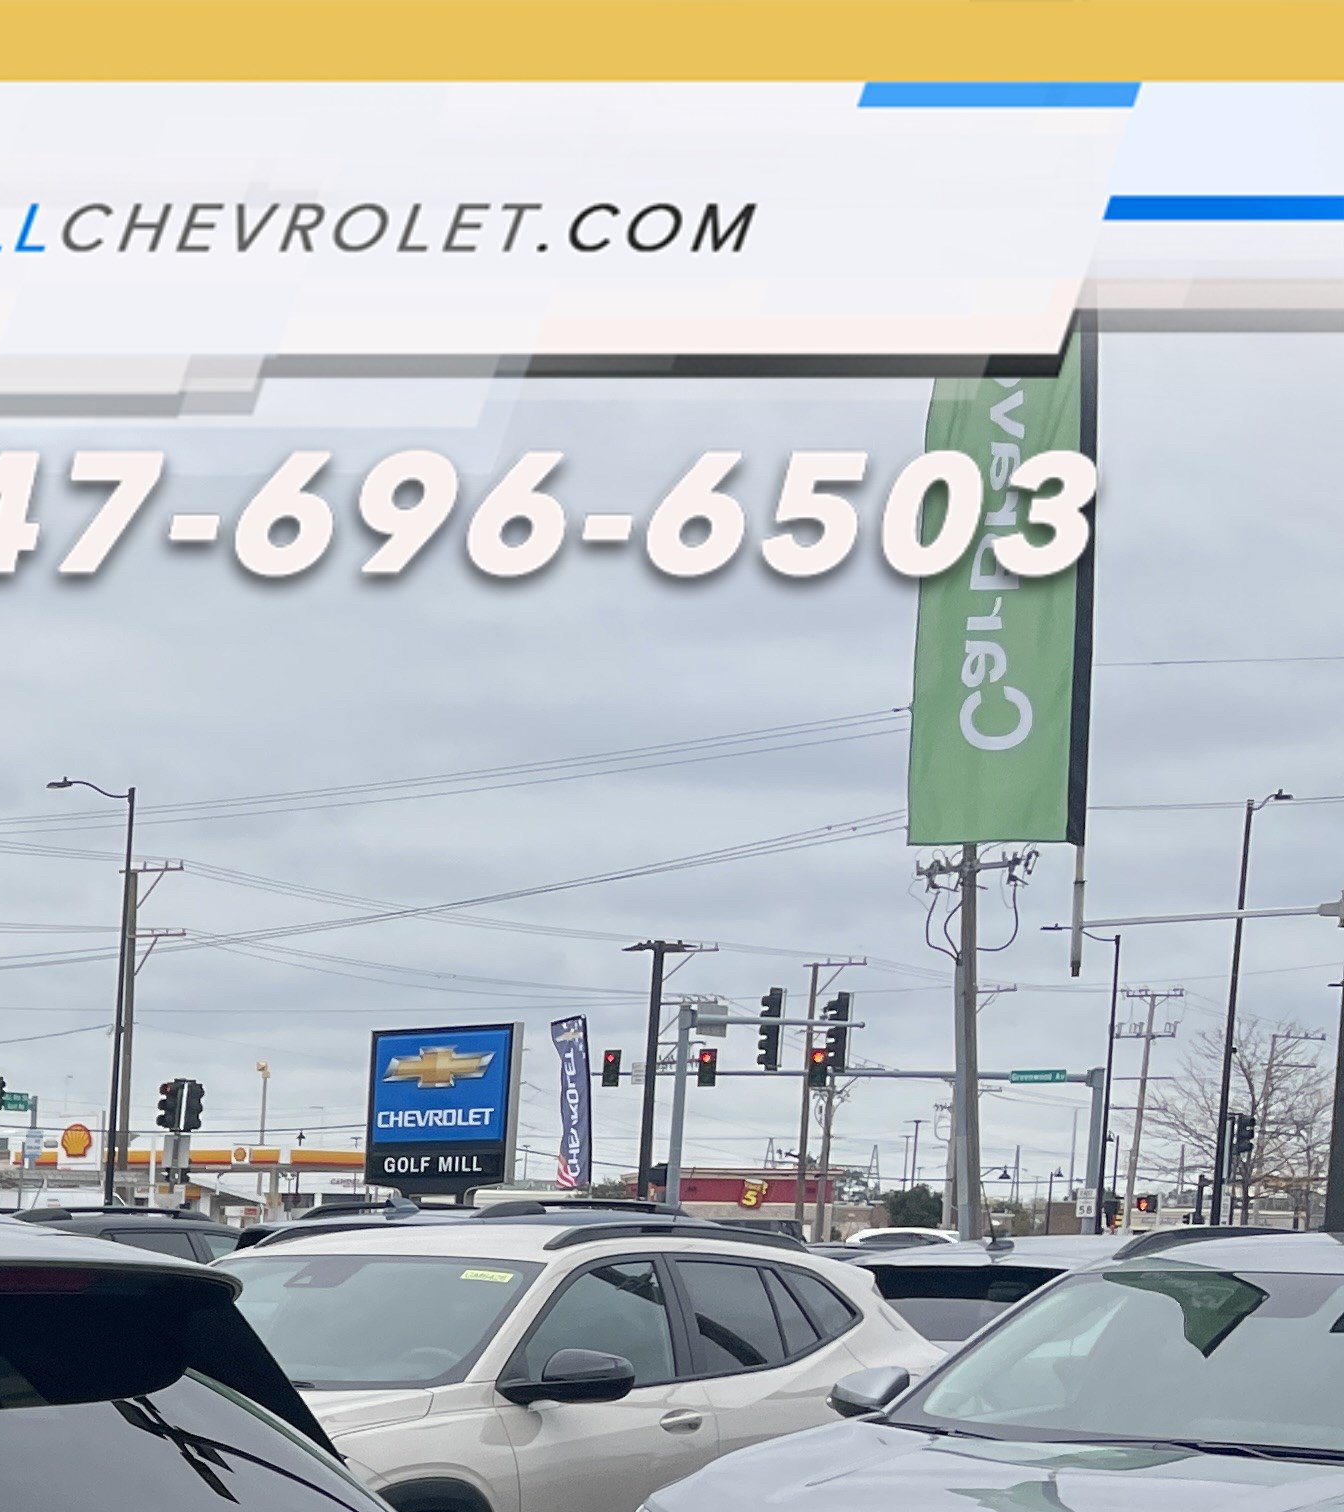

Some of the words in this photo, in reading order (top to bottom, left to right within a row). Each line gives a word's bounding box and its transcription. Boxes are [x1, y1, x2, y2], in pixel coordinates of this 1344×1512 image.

[376, 1107, 495, 1129] CHEVROLET
[383, 1157, 431, 1174] GOLF
[438, 1155, 483, 1173] MILL
